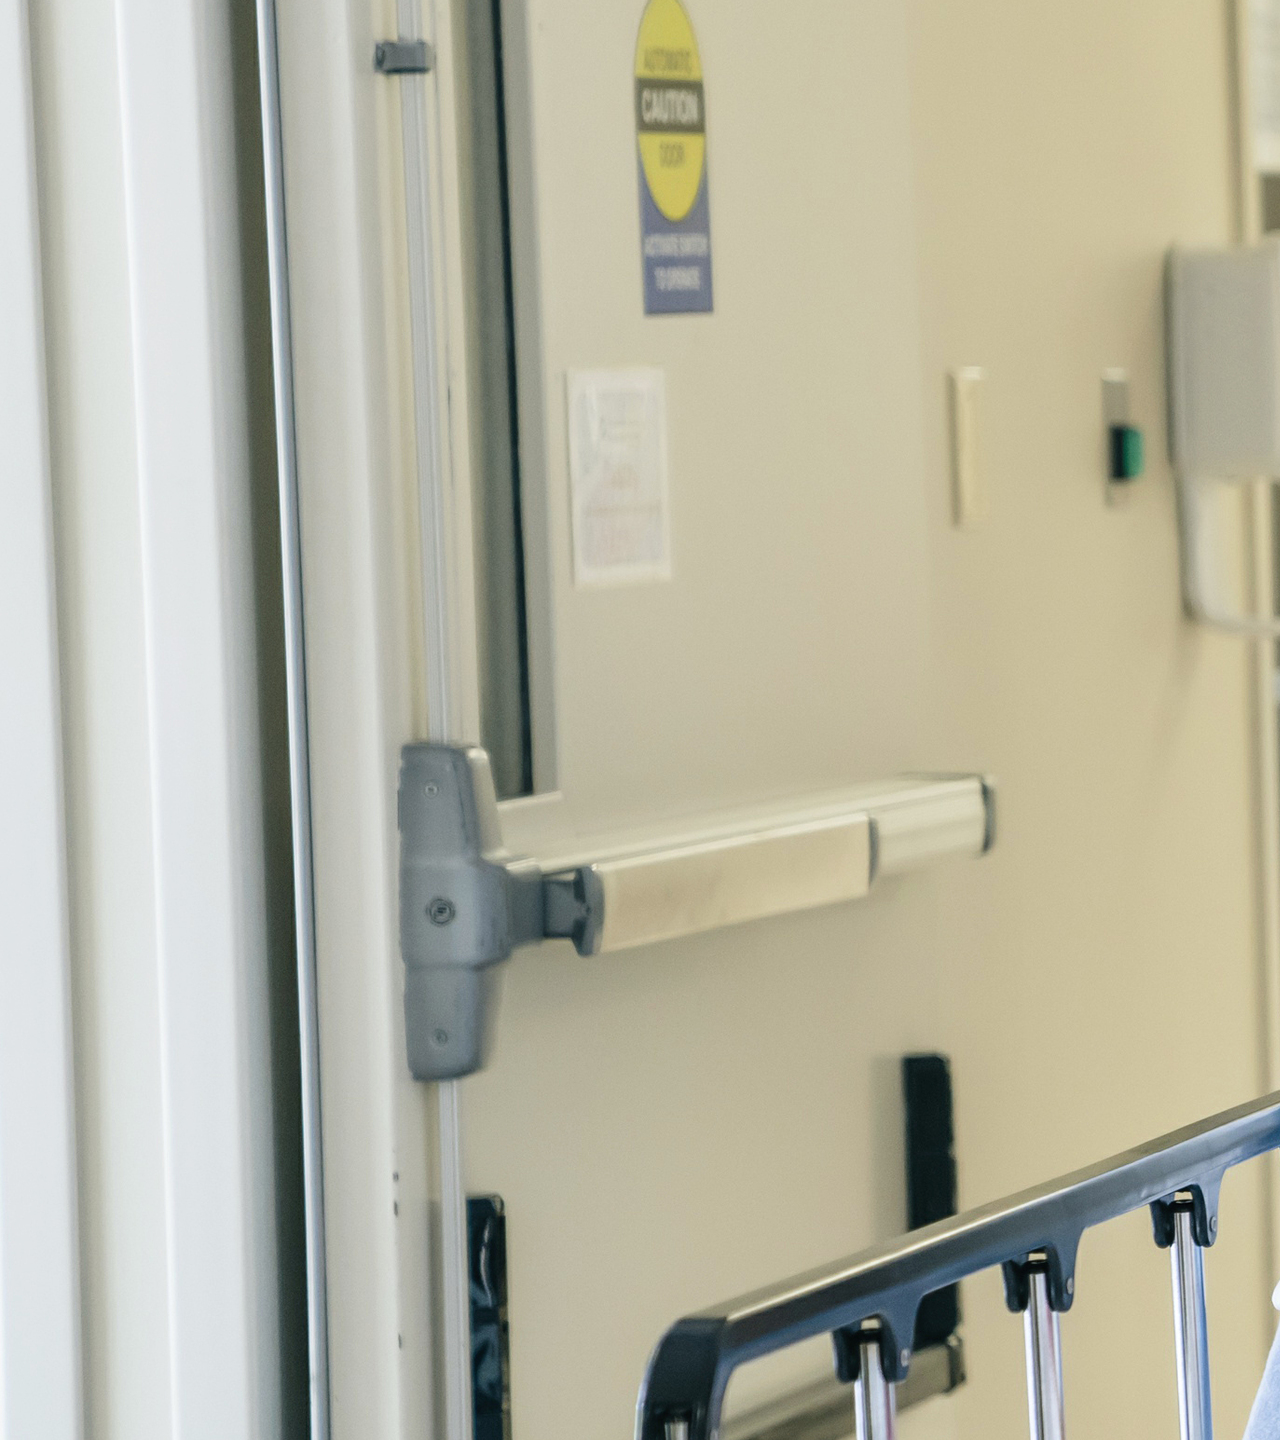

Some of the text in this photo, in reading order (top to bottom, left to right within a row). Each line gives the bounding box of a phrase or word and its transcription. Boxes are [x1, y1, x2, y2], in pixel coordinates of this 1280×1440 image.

[644, 46, 692, 72] AUTOMATIC
[642, 87, 698, 124] CAUTION
[659, 142, 685, 167] DOOR
